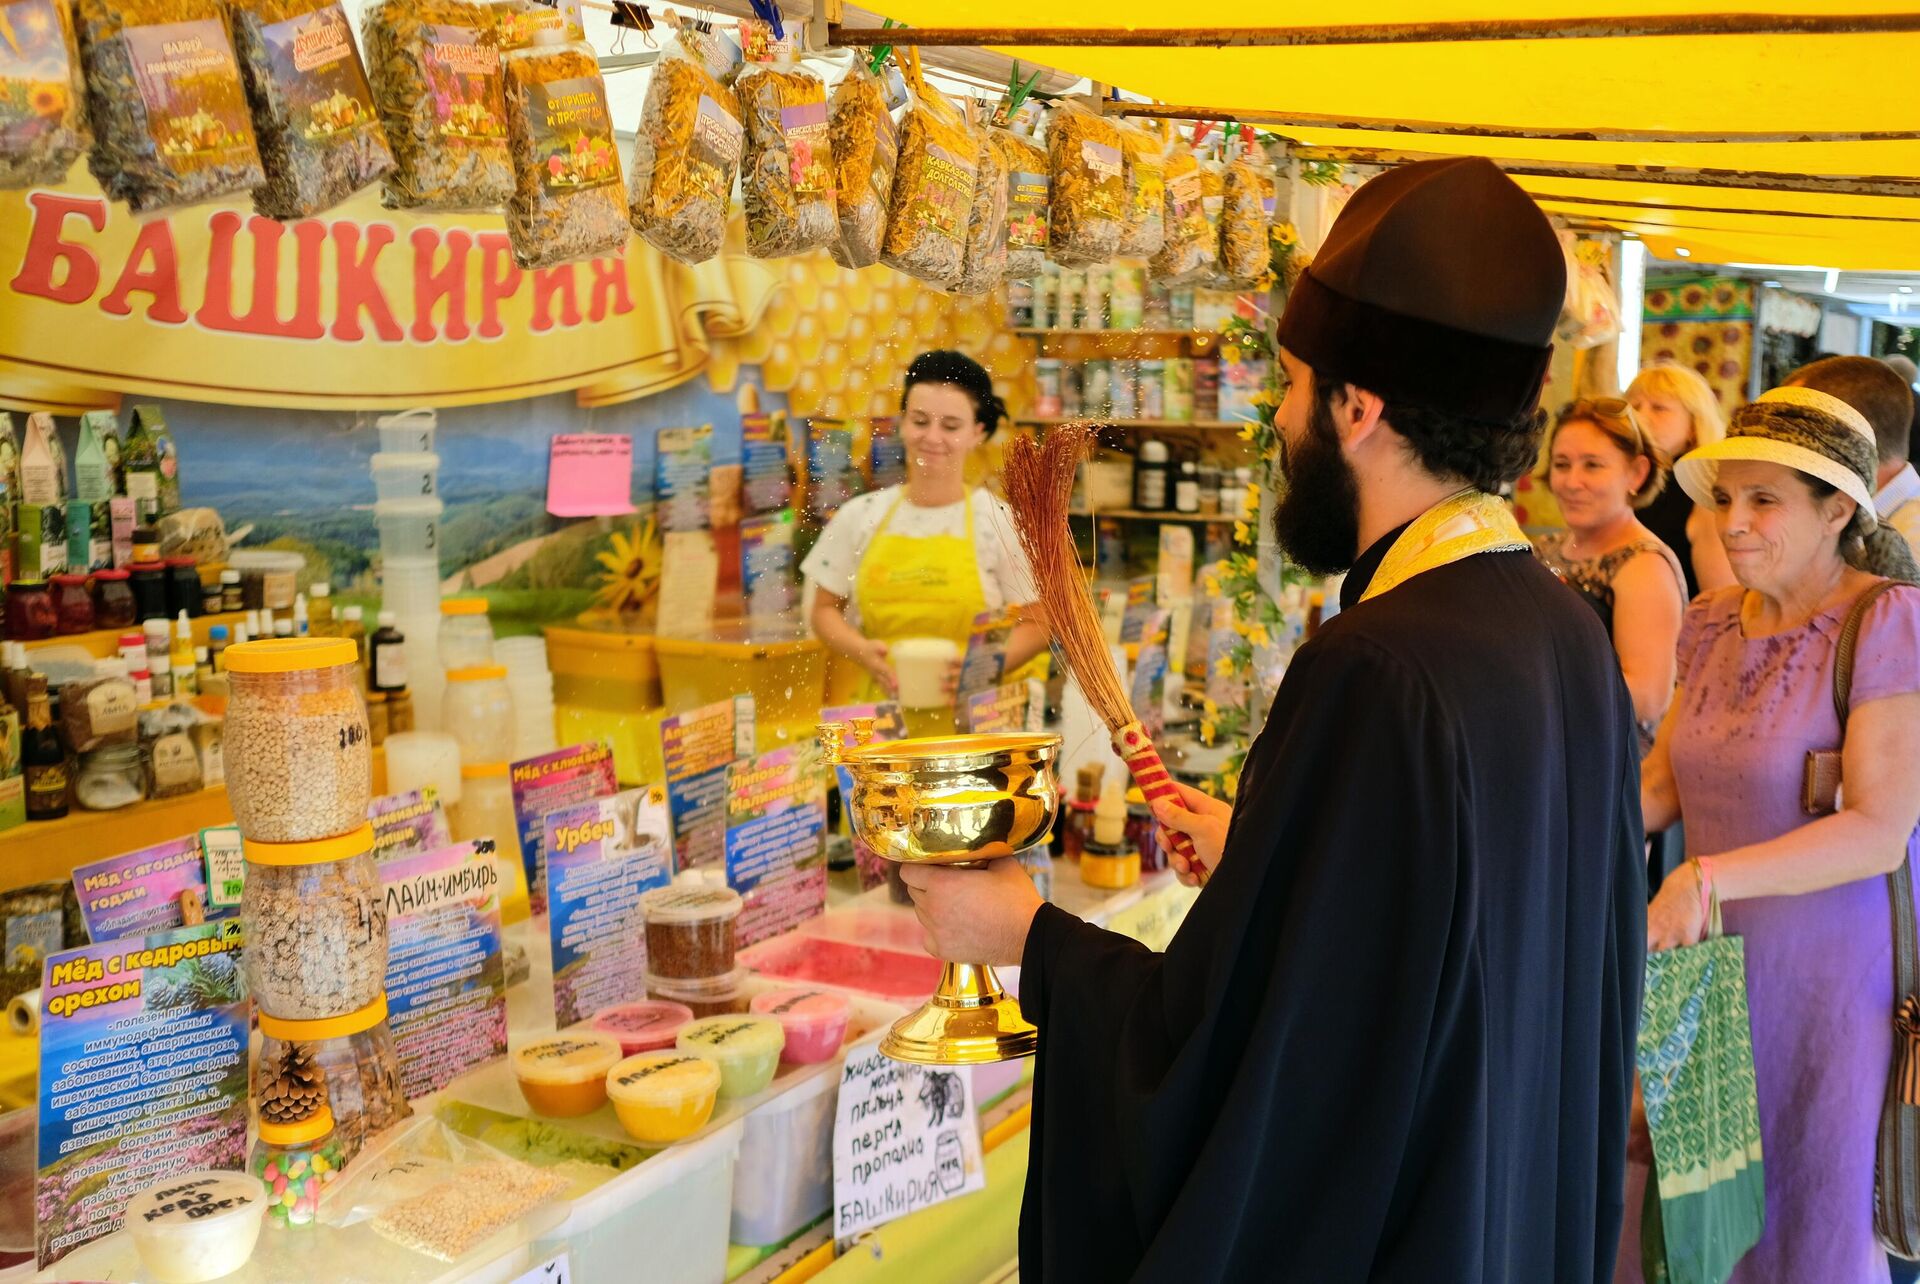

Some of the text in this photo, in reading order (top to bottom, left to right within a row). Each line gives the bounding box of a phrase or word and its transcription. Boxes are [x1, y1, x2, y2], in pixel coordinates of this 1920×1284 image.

[546, 107, 603, 127] И ПРОСТУДЫ
[547, 92, 597, 110] ОТ ГРИППА
[926, 154, 975, 187] КАВКАЗСКОЕ
[10, 192, 634, 343] БАШКИРИЯ
[420, 432, 429, 452] 1
[421, 473, 433, 495] 2
[426, 523, 436, 550] 3
[514, 763, 541, 784] Мёд
[551, 748, 609, 772] клюквой
[555, 818, 616, 854] Урбеч
[82, 871, 122, 895] Мёд
[123, 867, 136, 882] с
[135, 847, 205, 880] ягодами
[89, 885, 149, 914] годжи
[51, 957, 104, 986] Мёд
[107, 956, 122, 973] с
[48, 979, 141, 1017] орехом
[85, 1015, 212, 1053] иммунодефицитных
[116, 1005, 191, 1030] полезен при
[52, 1040, 239, 1092] заболеваниях, атеросклерозе,
[62, 1025, 231, 1074] состояниях, аллергических
[51, 1053, 240, 1109] ишемической болезни сердца,
[65, 1071, 228, 1121] заболеваниях желудочно-
[60, 1098, 231, 1154] язвенной и желчекаменной
[73, 1107, 142, 1134] кишечного
[143, 1097, 184, 1115] тракта
[186, 1092, 195, 1103] в
[71, 1128, 227, 1180] повышает физическую и
[120, 1129, 177, 1152] болезни;
[107, 1155, 187, 1185] умственную
[52, 1222, 112, 1253] развития
